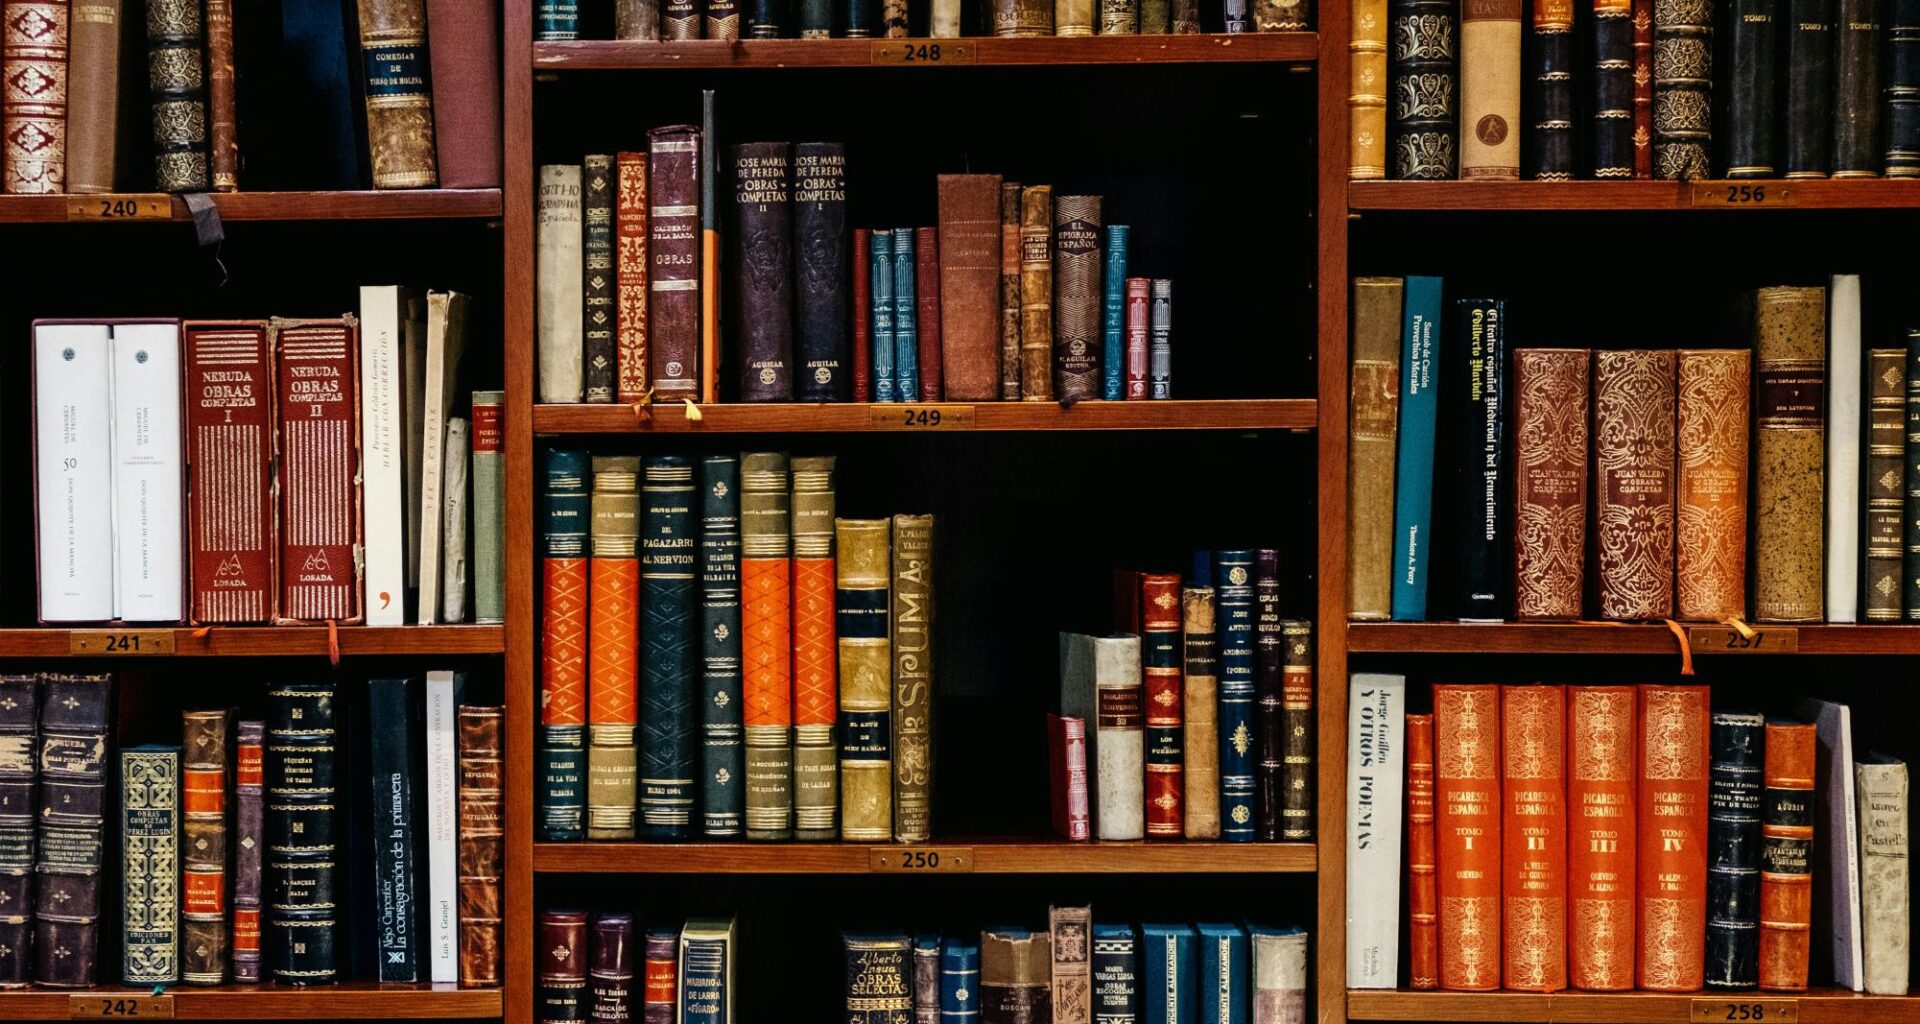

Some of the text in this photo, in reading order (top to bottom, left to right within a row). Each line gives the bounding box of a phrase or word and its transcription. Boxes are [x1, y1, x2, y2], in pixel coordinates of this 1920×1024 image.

[375, 52, 415, 61] COMEDIAS
[904, 45, 941, 61] 248
[390, 64, 402, 72] DE
[736, 158, 787, 168] JOSE MARIA
[796, 156, 845, 166] JOSE MARIA
[738, 168, 785, 178] DE PEREDA
[796, 166, 844, 176] DE PEREDA
[744, 180, 778, 191] OBRAS
[803, 178, 837, 190] OBRAS
[736, 191, 787, 203] COMPLETAS
[795, 190, 845, 202] COMPLETAS
[1727, 187, 1765, 202] 256
[101, 201, 138, 217] 240
[759, 204, 767, 212] II
[1071, 222, 1084, 231] EL
[1058, 231, 1097, 240] EPIGRAMA
[1058, 240, 1097, 249] ESPAÑOL
[656, 254, 694, 265] OBRAS
[1471, 308, 1483, 357] Edilberto
[1485, 324, 1496, 353] teatro
[1410, 314, 1423, 395] Proverbios Morales
[1422, 348, 1431, 358] de
[752, 361, 784, 369] AGUILAR
[808, 360, 840, 368] AGUILAR
[202, 371, 253, 382] NERUDA
[290, 366, 341, 378] NERUDA
[1484, 355, 1497, 394] español
[203, 384, 252, 398] OBRAS
[291, 379, 339, 394] OBRAS
[200, 397, 257, 408] COMPLETAS
[288, 391, 344, 403] COMPLETAS
[224, 409, 233, 423] I
[310, 404, 324, 417] II
[904, 409, 941, 426] 249
[1483, 397, 1497, 443] Medieval
[63, 457, 78, 472] 50
[1485, 453, 1497, 468] del
[1529, 470, 1554, 479] JUAN
[1615, 469, 1665, 479] JUAN VALERA
[1630, 478, 1656, 486] OBRAS
[1533, 485, 1577, 493] COMPLETAS
[1619, 485, 1662, 493] COMPLETAS
[1691, 485, 1737, 494] COMPLETAS
[1483, 470, 1497, 541] Renacimiento
[643, 538, 694, 548] PAGAZARRI
[642, 555, 694, 565] AL NERVION
[299, 573, 334, 584] LOSADA
[213, 580, 248, 590] LOSADA
[1259, 595, 1279, 603] COPLAS
[1264, 604, 1273, 612] DE
[106, 635, 140, 652] 241
[1376, 689, 1391, 720] Jorge
[1357, 689, 1375, 850] Y OTROS POEMAS
[1447, 791, 1490, 802] PICARESCA
[1514, 791, 1556, 802] PICARESCA
[1583, 793, 1624, 804] PICARESCA
[1654, 792, 1696, 804] PICARESCA
[137, 810, 161, 818] OBRAS
[1448, 804, 1489, 816] ESPAÑOLA
[1515, 804, 1555, 816] ESPAÑOLA
[1583, 805, 1624, 818] ESPAÑOLA
[1654, 805, 1696, 817] ESPAÑOLA
[130, 816, 169, 824] COMPLETAS
[1455, 828, 1484, 836] TOMO
[1523, 828, 1550, 836] TOMO
[1590, 831, 1618, 839] TOMO
[1660, 829, 1688, 838] TOMO
[1464, 837, 1473, 850] I
[1527, 838, 1546, 851] II
[1590, 840, 1618, 853] III
[1663, 839, 1685, 852] IV
[391, 773, 410, 949] La consagración de la primavera
[903, 852, 940, 868] 250
[1456, 870, 1484, 880] QUEVEDO
[1590, 872, 1618, 881] QUEVEDO
[380, 879, 396, 949] Alejo Carpentier
[440, 900, 450, 929] Granjel
[861, 952, 903, 965] Alberto
[687, 977, 714, 986] MARIANO
[857, 974, 902, 985] OBRAS
[1096, 972, 1117, 980] VARGAS
[688, 991, 721, 1000] DE LARRA
[851, 985, 908, 995] SELECTAS
[102, 1000, 138, 1015] 242
[1726, 1004, 1764, 1020] 258
